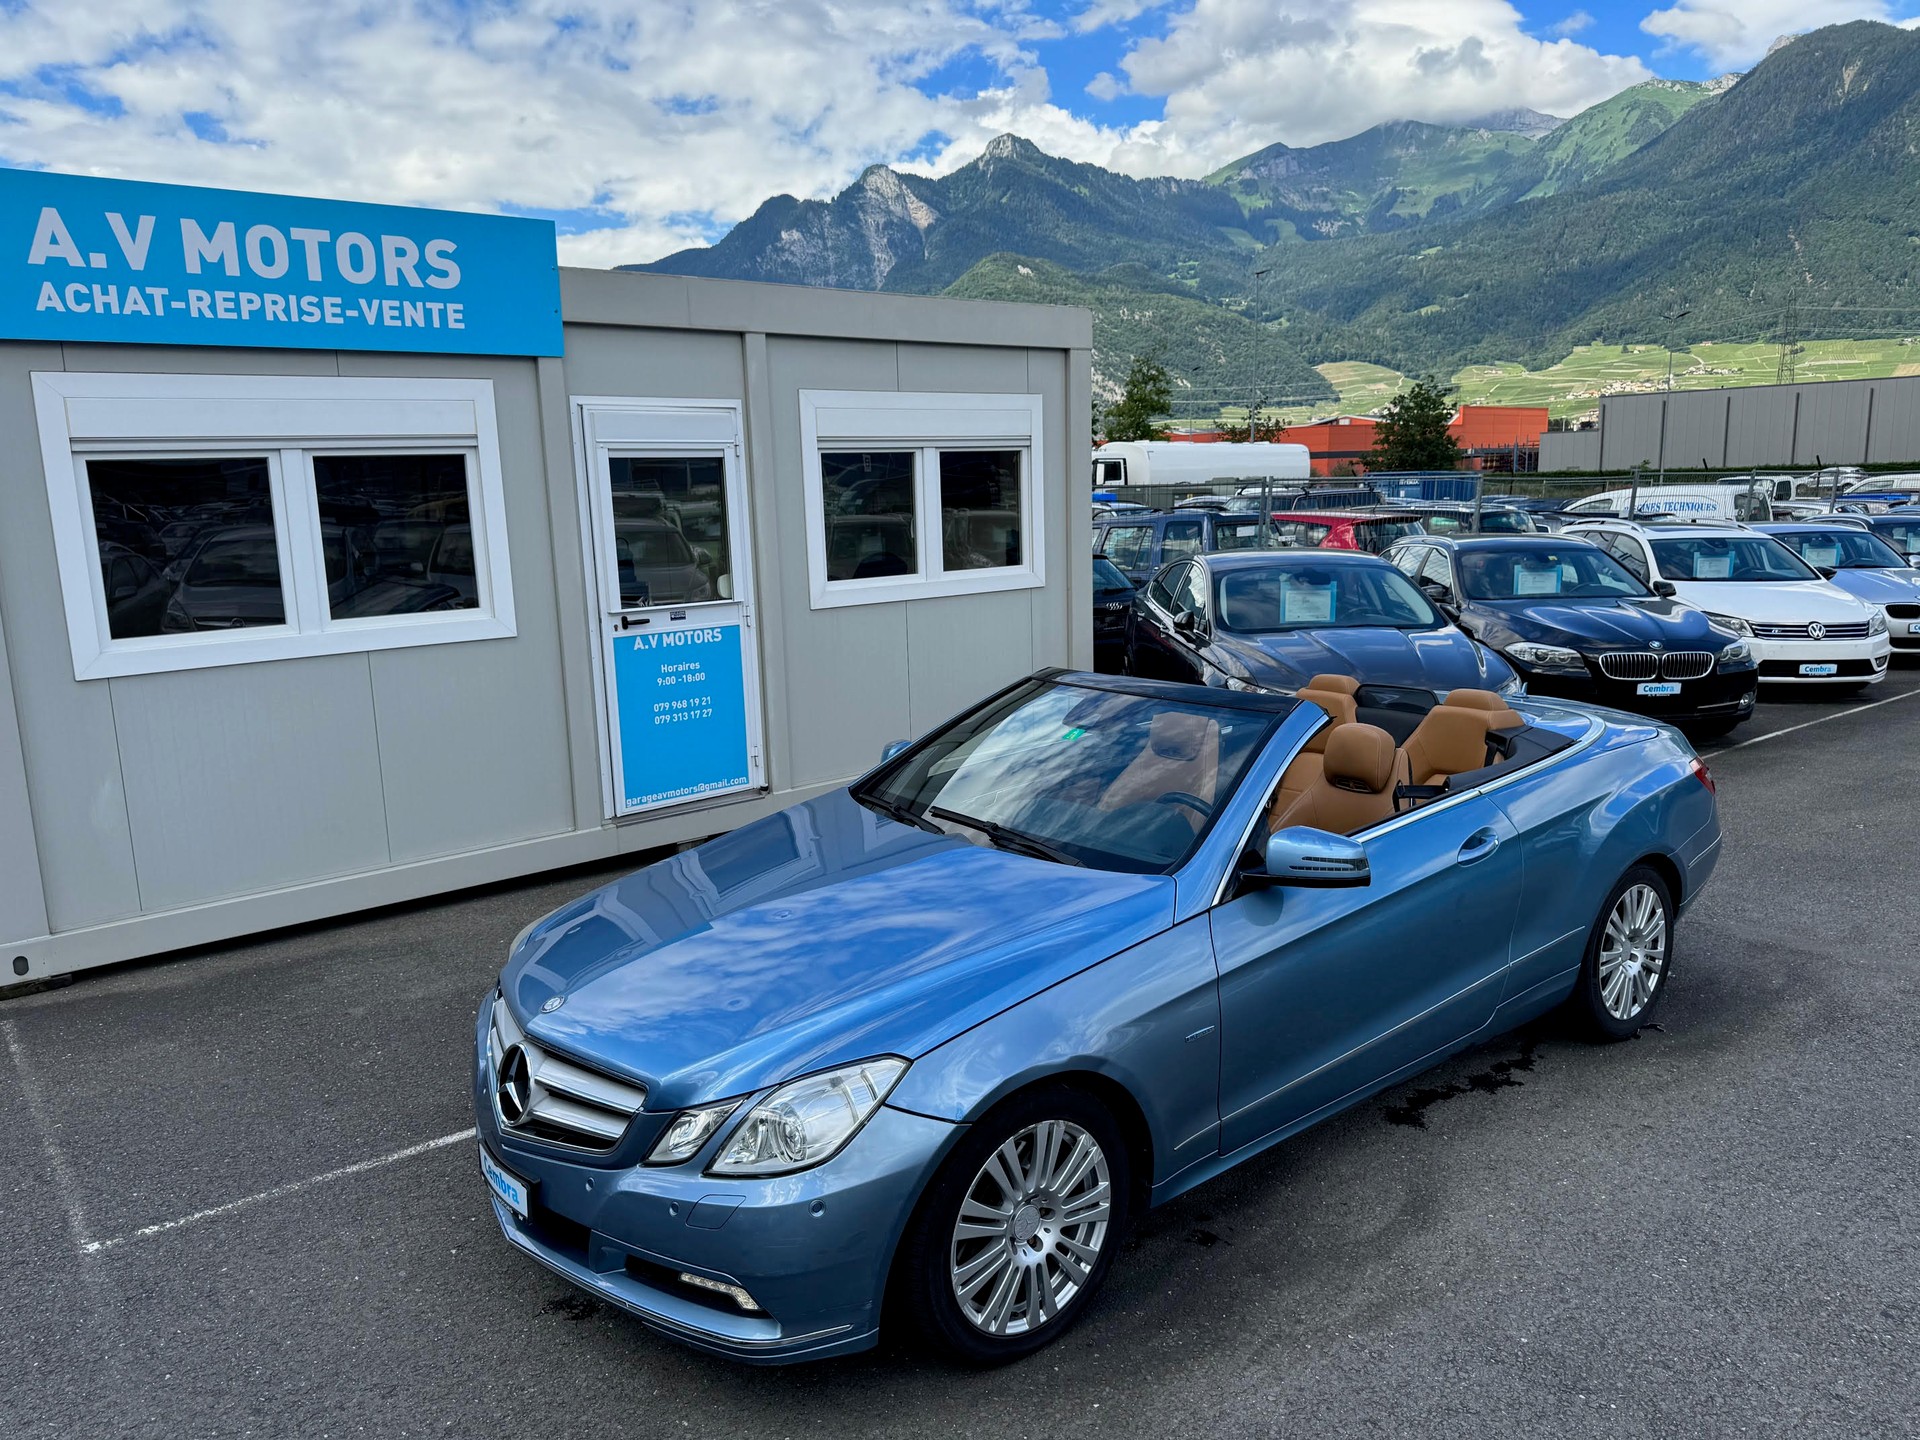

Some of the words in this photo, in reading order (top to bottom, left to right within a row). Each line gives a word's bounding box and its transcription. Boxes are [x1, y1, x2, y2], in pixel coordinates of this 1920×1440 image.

[28, 207, 155, 271] A.V
[180, 218, 461, 290] MOTORS
[36, 281, 465, 329] ACHAT-REPRISE-VENTE
[633, 634, 658, 651] A.V
[662, 628, 722, 648] MOTORS
[661, 661, 700, 673] Horaires
[1804, 665, 1832, 673] Cembra
[657, 676, 676, 686] 9:00
[1643, 684, 1675, 693] Cembra
[653, 702, 670, 712] 079
[671, 699, 688, 710] 968
[689, 697, 700, 707] 19
[701, 695, 711, 706] 21
[654, 714, 671, 725] 079
[672, 711, 689, 722] 313
[690, 710, 701, 719] 17
[702, 708, 713, 718] 27
[626, 776, 748, 807] garageavmotors@gmail.com
[483, 1154, 520, 1206] Cembra
